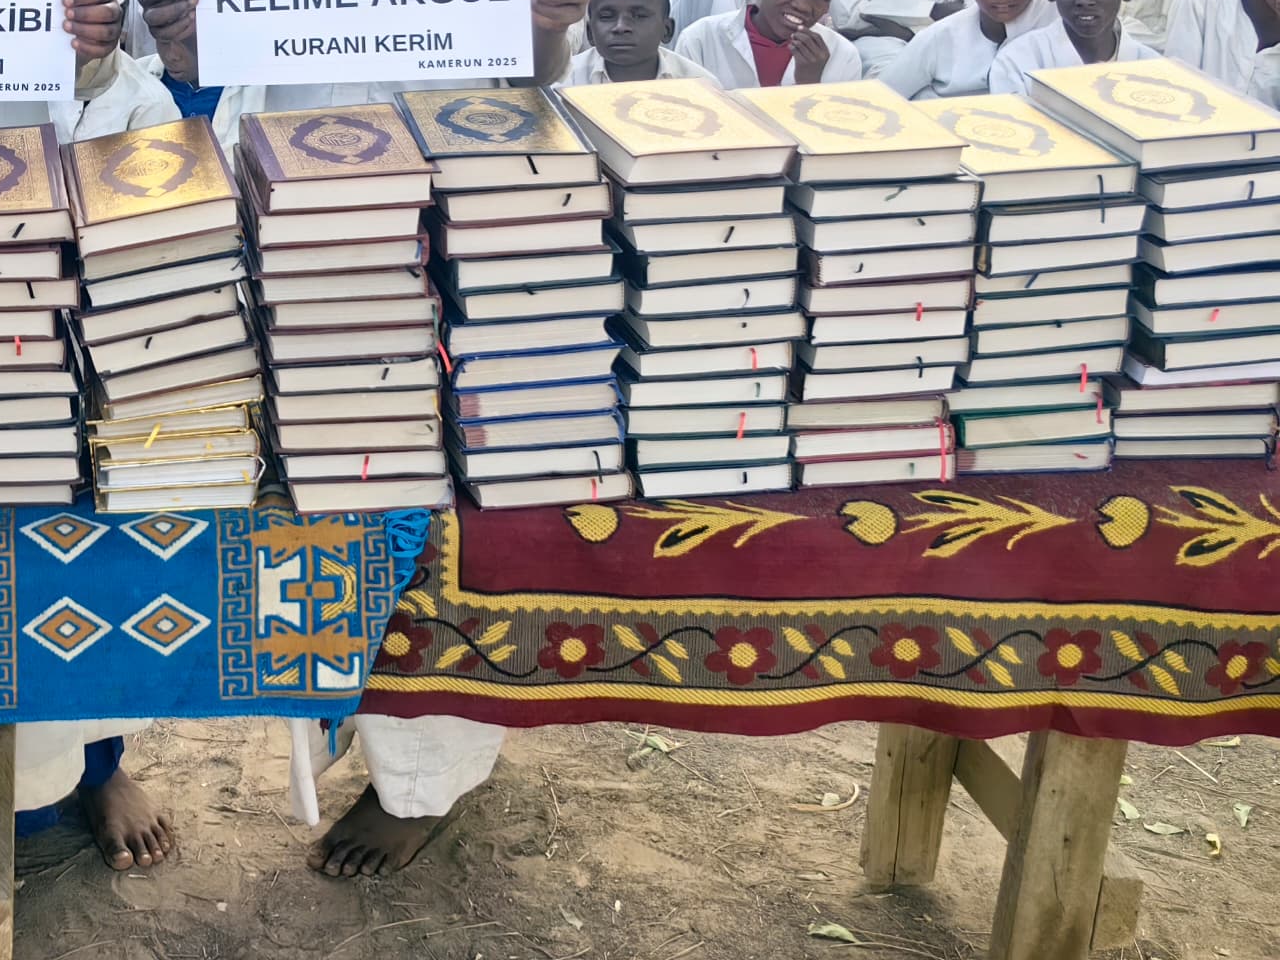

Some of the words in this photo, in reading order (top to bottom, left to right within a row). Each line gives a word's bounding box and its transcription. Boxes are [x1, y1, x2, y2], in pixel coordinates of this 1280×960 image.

[274, 36, 366, 56] KURANI
[375, 29, 452, 52] KERİM
[418, 58, 482, 69] KAMERUN
[487, 57, 517, 67] 2025
[33, 82, 61, 92] 2025
